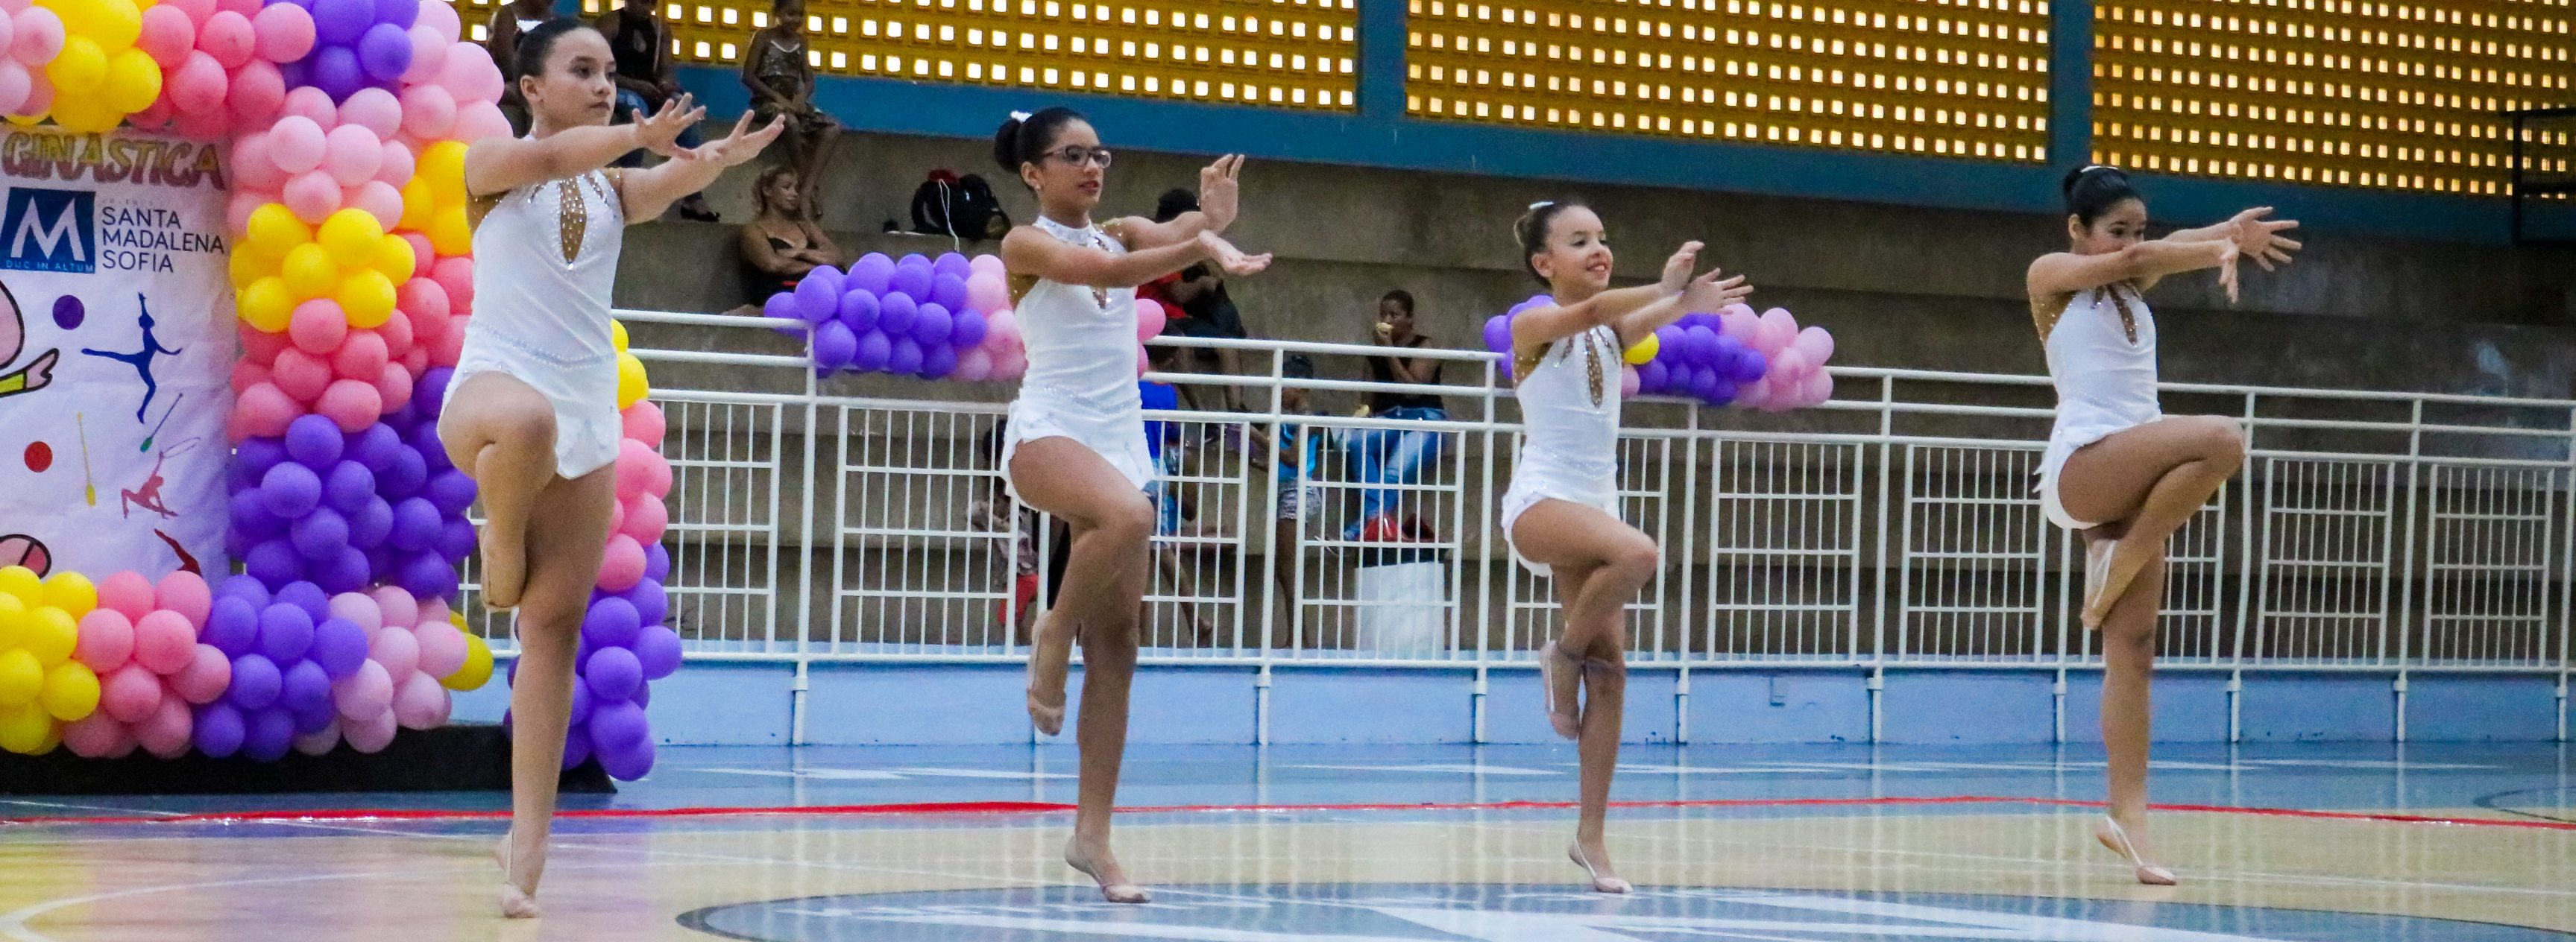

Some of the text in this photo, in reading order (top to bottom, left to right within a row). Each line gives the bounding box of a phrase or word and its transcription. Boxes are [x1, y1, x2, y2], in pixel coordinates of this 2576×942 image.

[10, 195, 86, 262] M
[101, 206, 182, 229] SANTA
[101, 228, 224, 254] MADALENA
[6, 259, 94, 272] DUC IN ALTUM
[101, 250, 174, 273] SOFIA
